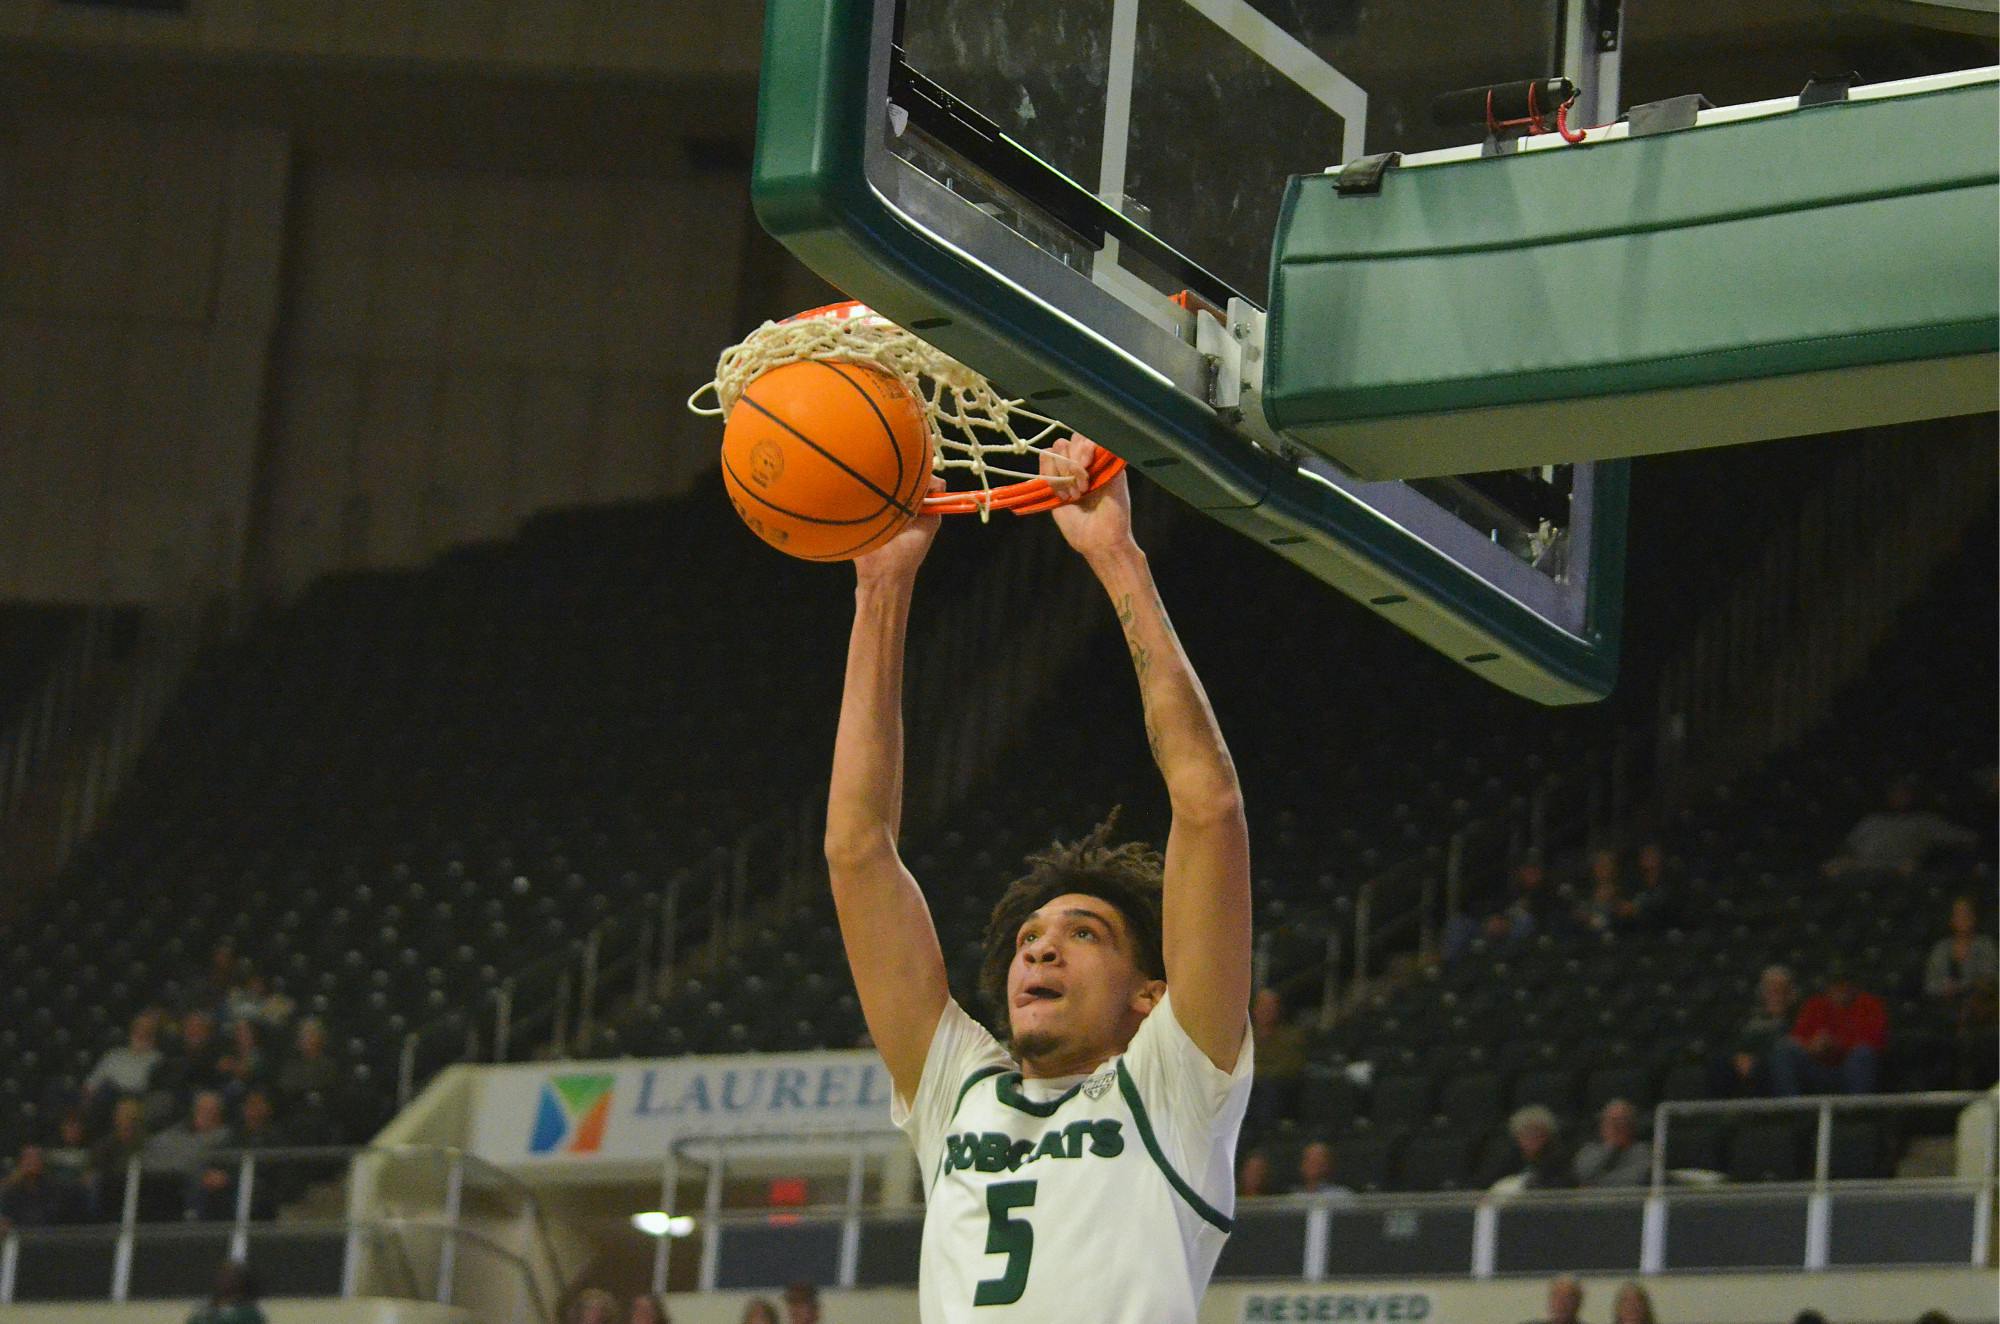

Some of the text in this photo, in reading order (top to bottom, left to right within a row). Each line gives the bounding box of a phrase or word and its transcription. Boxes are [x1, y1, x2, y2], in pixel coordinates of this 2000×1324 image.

[635, 1066, 889, 1116] LAUREL
[973, 1179, 1039, 1308] 5
[1246, 1295, 1431, 1321] RESERVED
